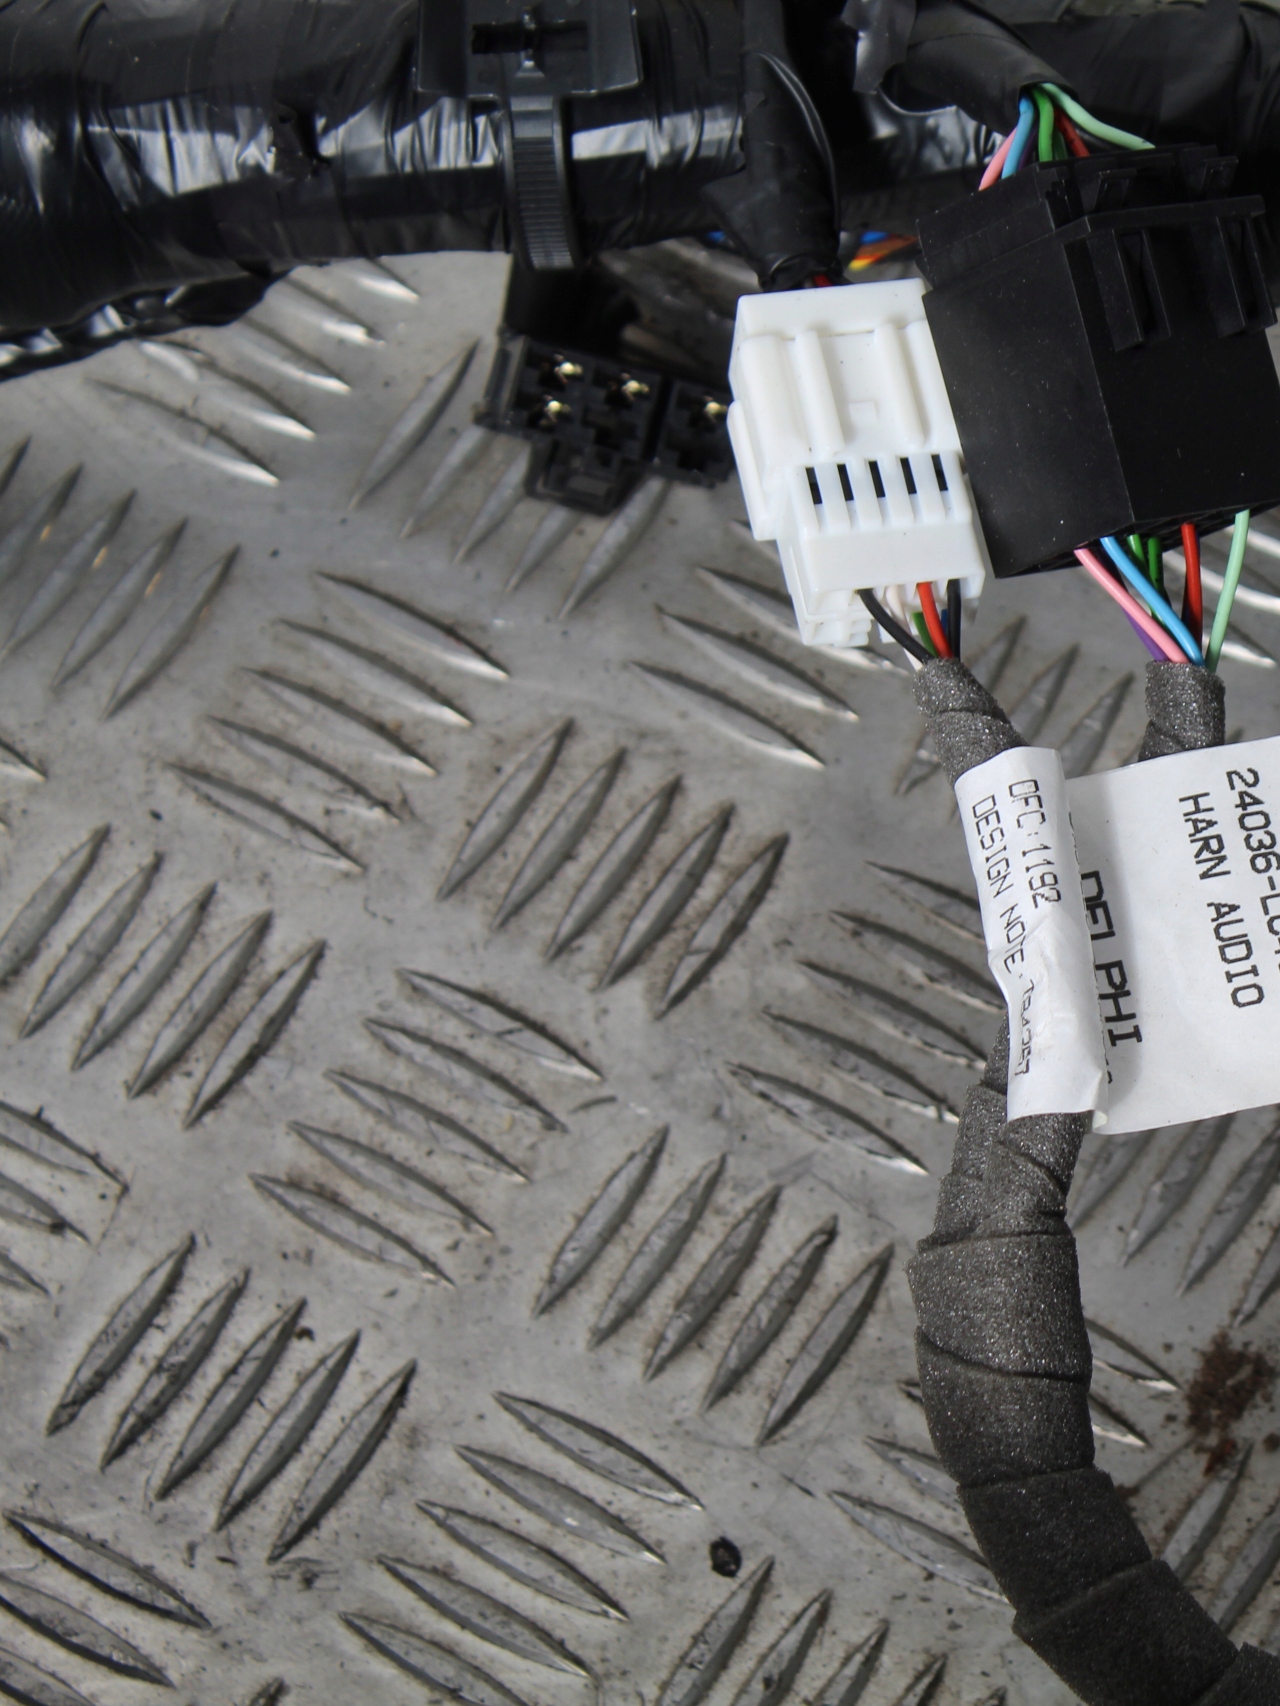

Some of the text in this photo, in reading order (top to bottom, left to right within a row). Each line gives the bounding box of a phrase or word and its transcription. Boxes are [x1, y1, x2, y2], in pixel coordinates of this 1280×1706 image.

[971, 794, 1014, 898] DESIGN
[1178, 792, 1264, 1008] HARN AUDIO
